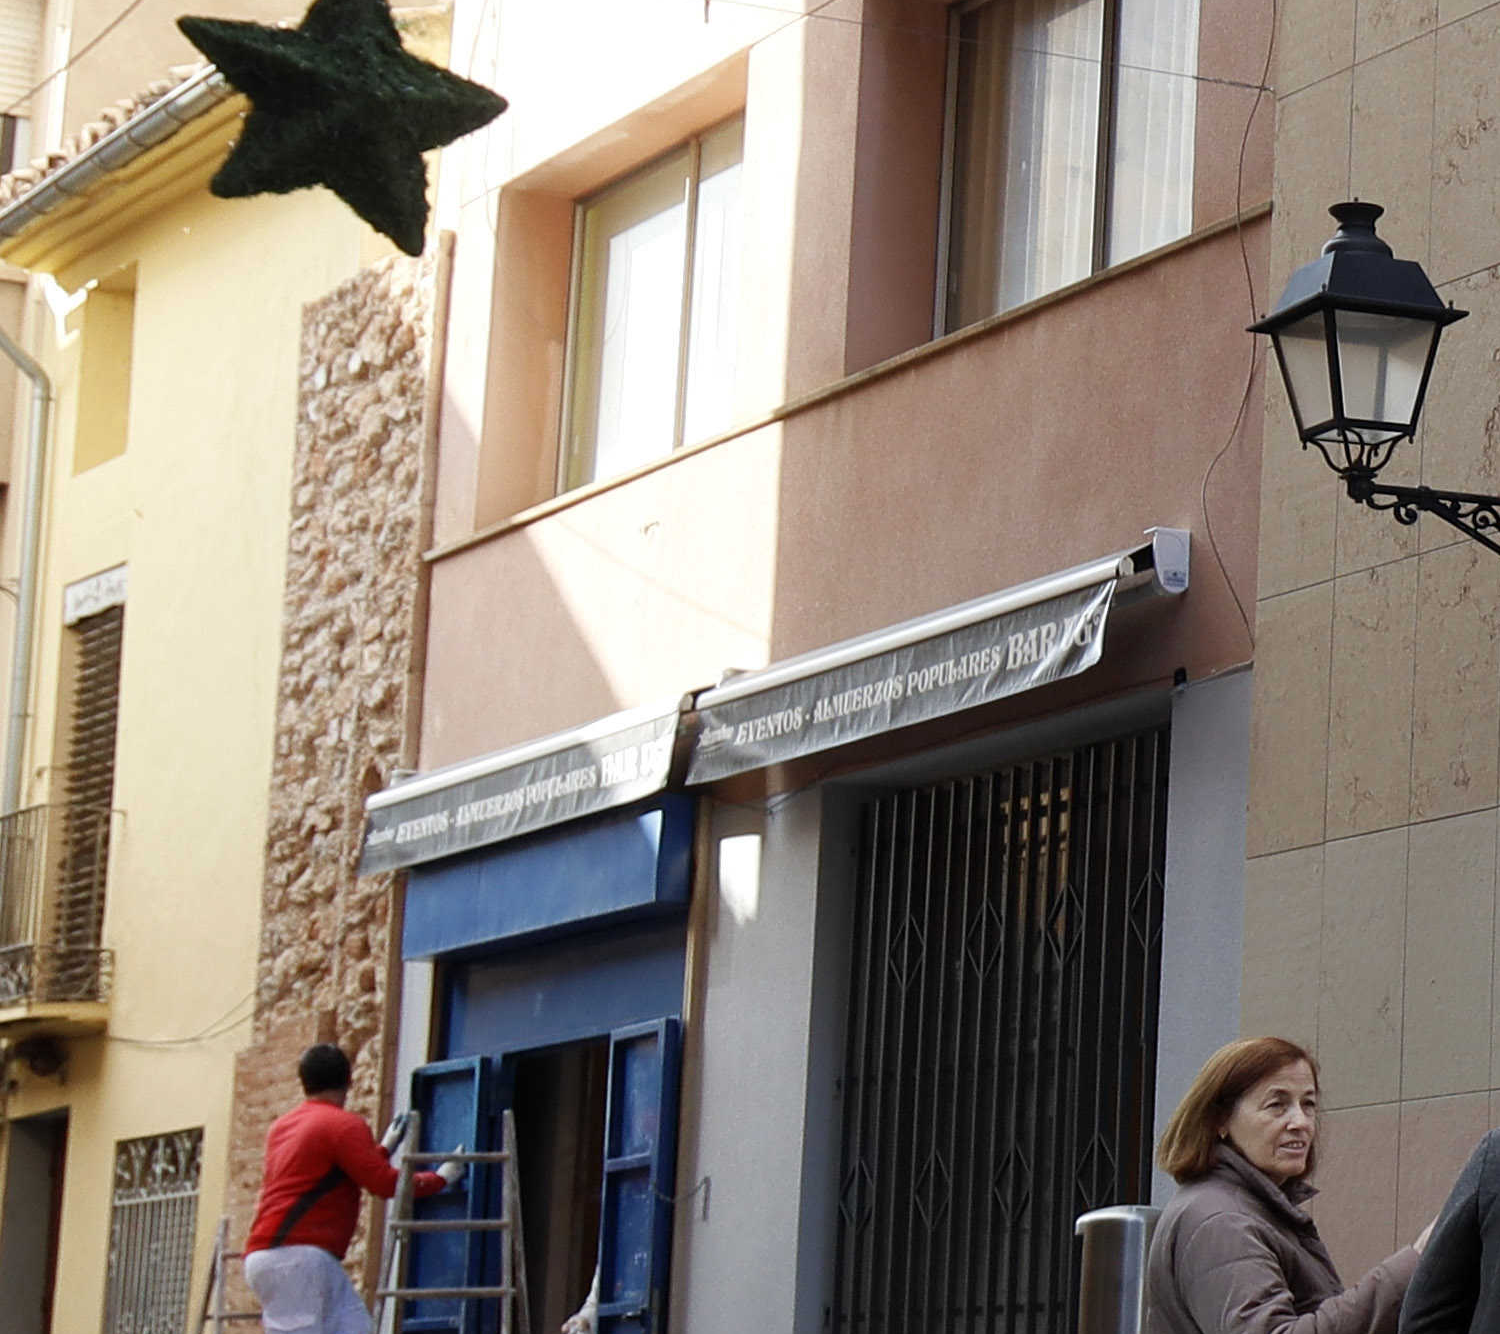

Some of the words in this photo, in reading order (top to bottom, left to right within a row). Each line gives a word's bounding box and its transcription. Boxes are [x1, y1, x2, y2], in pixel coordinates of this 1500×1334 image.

[733, 706, 802, 746] EVENTOS
[813, 674, 904, 724] ALMUERZOS
[905, 644, 1001, 697] POPULARES
[1006, 621, 1057, 670] BAR
